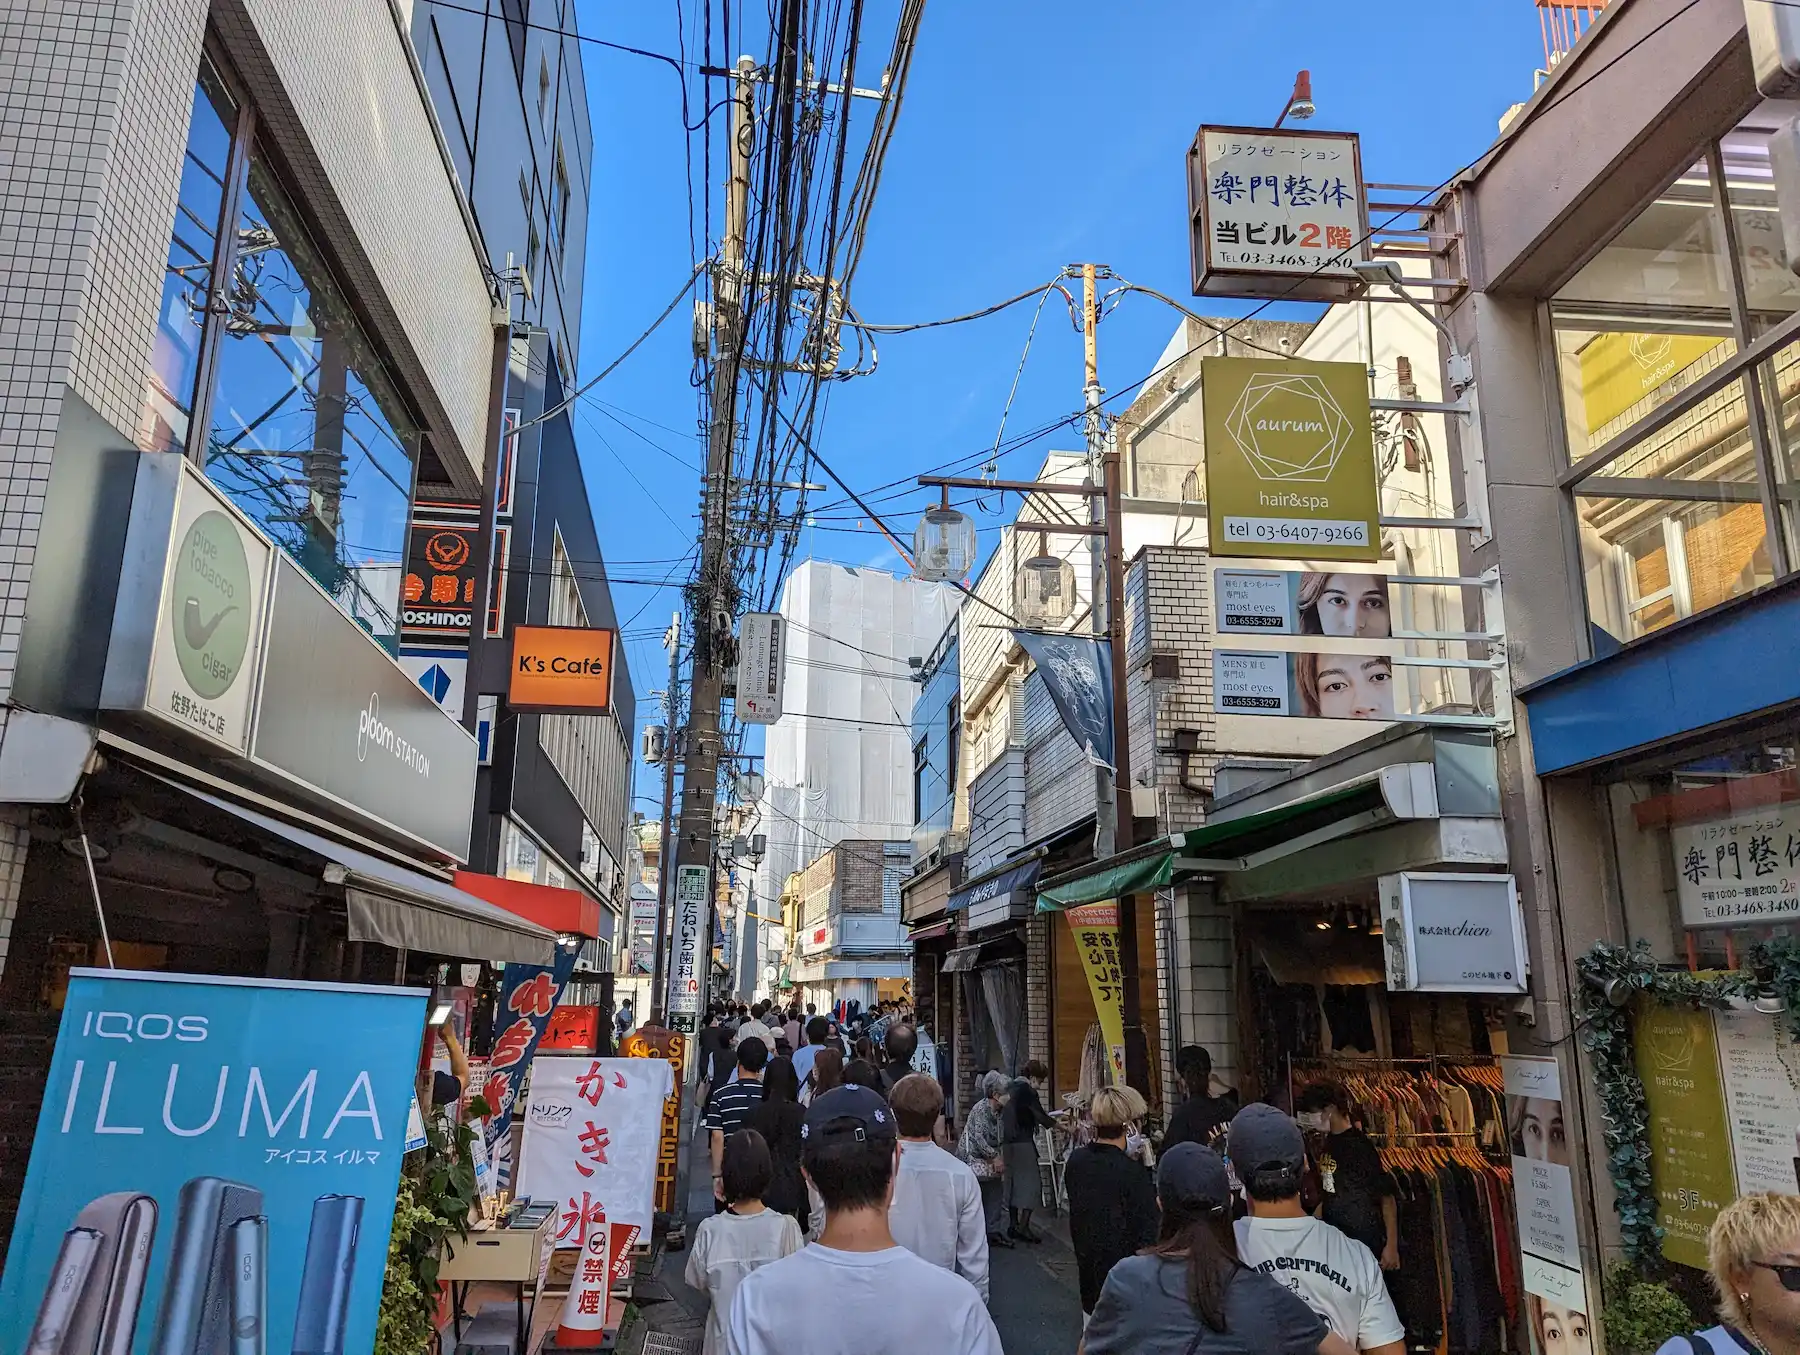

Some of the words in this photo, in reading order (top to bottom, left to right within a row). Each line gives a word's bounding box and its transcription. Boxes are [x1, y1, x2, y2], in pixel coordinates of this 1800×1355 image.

[1217, 143, 1341, 160] リラクゼーション
[1210, 171, 1354, 209] 楽門整体
[1216, 220, 1352, 250] 当ビル2階
[1219, 251, 1238, 263] TEL
[1240, 251, 1353, 269] 03-3468-3480
[1641, 358, 1676, 389] hair&spa
[1256, 418, 1324, 433] aurum
[1259, 490, 1329, 511] hair&spa
[1228, 521, 1250, 537] tel
[1256, 523, 1363, 542] 03-6407-9266
[192, 527, 218, 561] pipe
[190, 550, 234, 600] tobacco
[1226, 590, 1249, 600] 専門店
[403, 610, 472, 627] OSHINO
[1226, 602, 1252, 612] most
[1253, 603, 1276, 614] eyes
[1226, 615, 1282, 626] 03-6555-3297
[201, 651, 232, 683] cigar
[519, 655, 545, 673] K's
[551, 657, 603, 676] Café
[1222, 660, 1248, 669] MENS
[1223, 670, 1246, 680] 専門店
[1223, 682, 1248, 693] most
[1250, 683, 1274, 695] eyes
[1223, 696, 1279, 708] 03-6555-3297
[171, 689, 226, 737] 佐野たばこ店
[395, 736, 430, 778] STATION
[1701, 818, 1784, 841] リラクゼーション
[1780, 878, 1796, 894] 2F
[1703, 907, 1716, 918] TEL
[1717, 897, 1799, 917] 03-3468-3480
[677, 901, 698, 979] たねいち歯科
[1462, 971, 1502, 980] このビル地下
[82, 1010, 209, 1043] IQOS
[672, 1024, 692, 1033] 2-25
[1655, 1075, 1695, 1089] hair&spa
[60, 1059, 384, 1141] ILUMA
[531, 1103, 573, 1117] ドリンク
[264, 1148, 328, 1164] アイコス
[333, 1149, 381, 1165] イルマ
[555, 1060, 628, 1246] かき氷
[1679, 1187, 1699, 1211] 3F
[137, 1231, 149, 1260] IQOS
[611, 1260, 622, 1272] NO
[618, 1226, 640, 1261] SMOKING
[243, 1252, 252, 1282] IQOS
[1253, 1256, 1352, 1293] UBCRITICAL
[61, 1264, 77, 1293] IQOS
[577, 1258, 604, 1315] 禁煙
